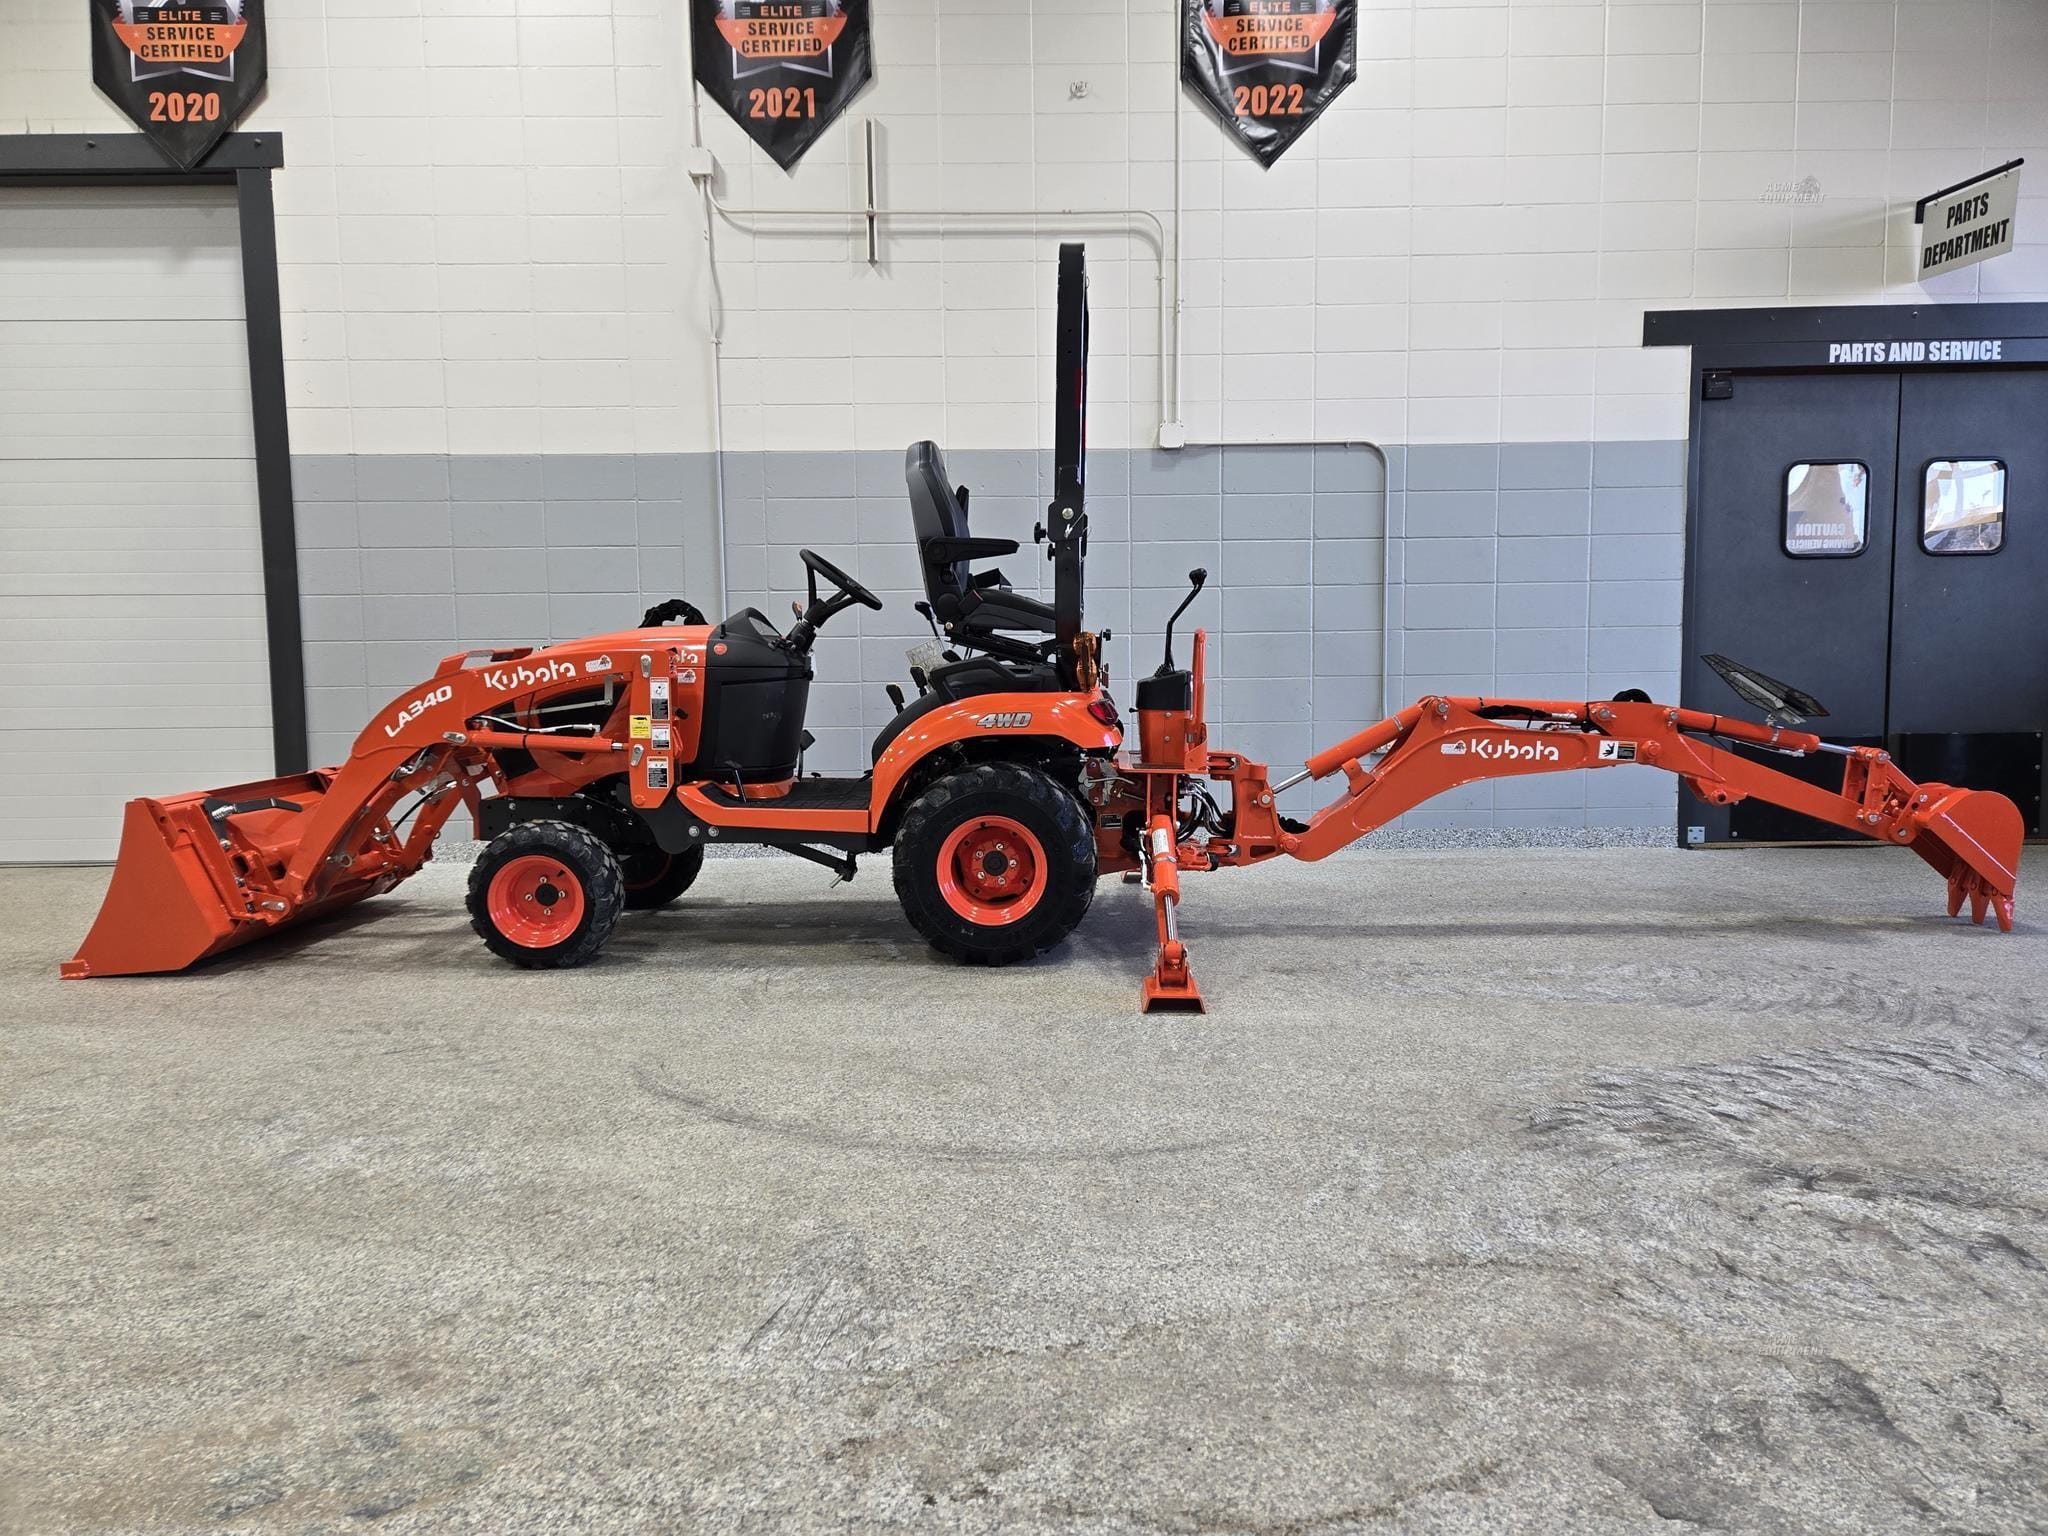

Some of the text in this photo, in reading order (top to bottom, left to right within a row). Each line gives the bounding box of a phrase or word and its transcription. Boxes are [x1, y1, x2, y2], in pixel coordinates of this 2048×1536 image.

[760, 5, 802, 17] ELITE
[1249, 1, 1291, 13] ELITE
[158, 10, 202, 21] ELITE
[147, 26, 215, 41] SERVICE
[748, 21, 814, 36] SERVICE
[1236, 18, 1303, 33] SERVICE
[741, 38, 822, 54] CERTIFIED
[1228, 35, 1310, 51] CERTIFIED
[140, 44, 224, 59] CERTIFIED
[148, 92, 220, 122] 2020
[749, 87, 816, 119] 2021
[1234, 83, 1305, 117] 2022
[1946, 192, 1989, 229] PARTS
[1923, 218, 2010, 269] DEPARTMENT
[1829, 340, 2002, 363] PARTS AND SERVICE
[483, 658, 577, 691] Kubota
[383, 685, 453, 738] LA340
[976, 712, 1033, 728] 4WD
[1471, 738, 1559, 761] Kubota
